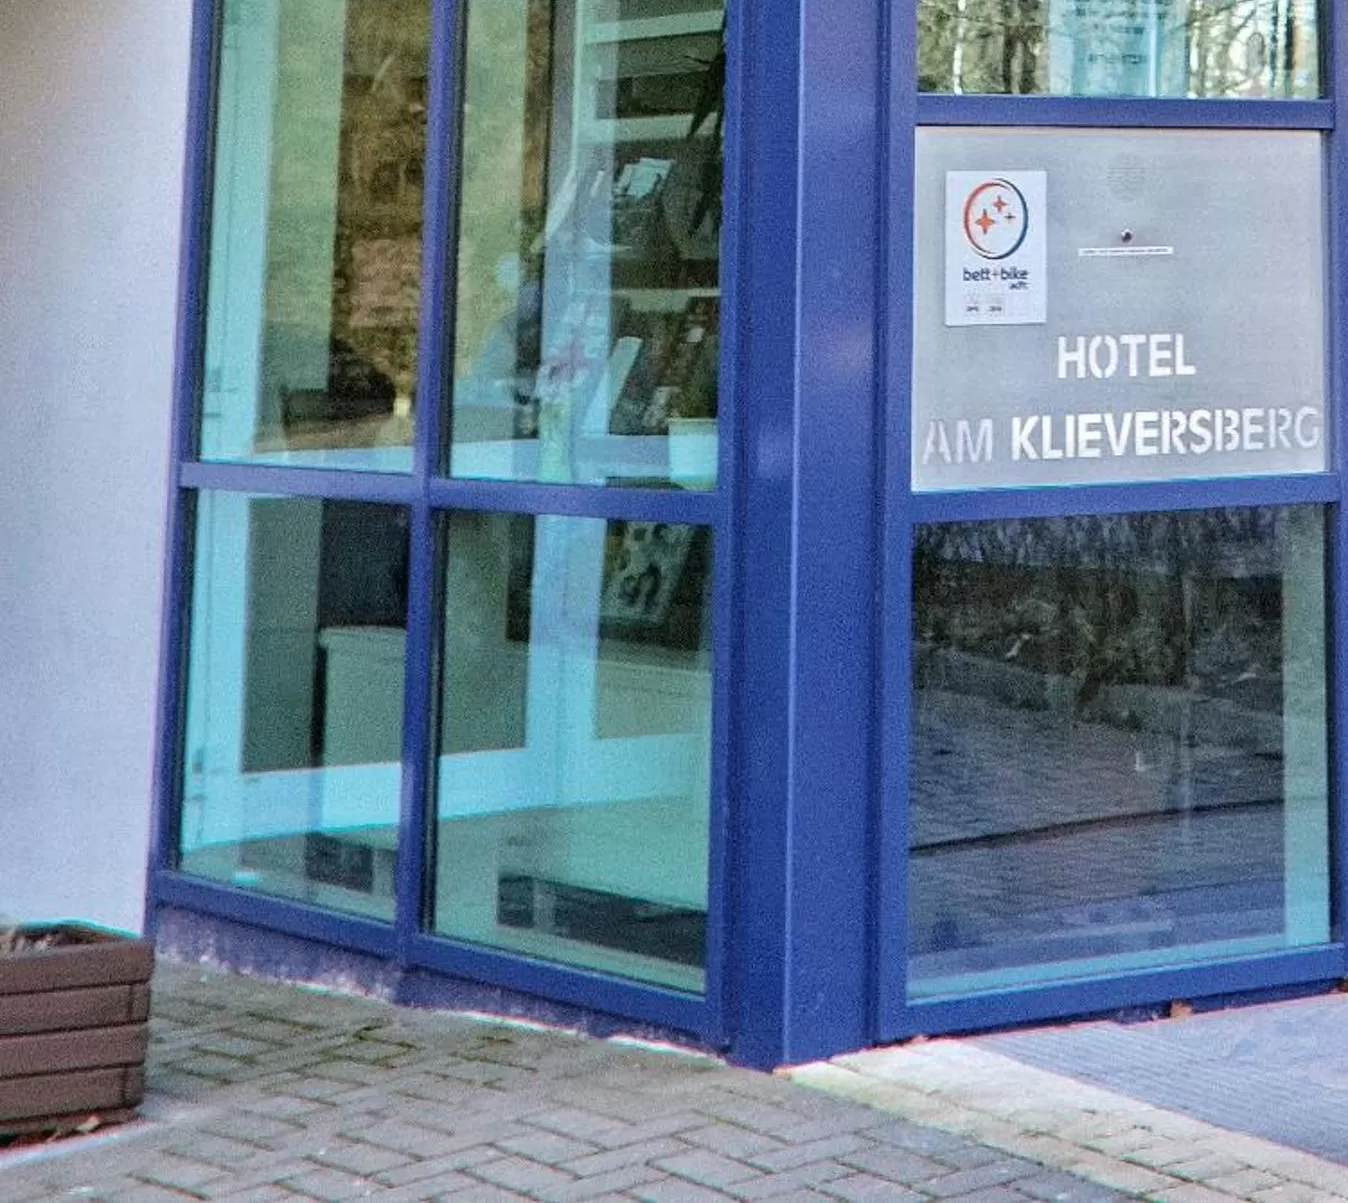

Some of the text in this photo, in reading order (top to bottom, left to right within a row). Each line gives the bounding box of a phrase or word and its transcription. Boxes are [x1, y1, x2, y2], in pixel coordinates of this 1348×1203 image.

[1057, 333, 1196, 379] HOTEL
[922, 406, 1320, 465] AM KLIEVERSBERG
